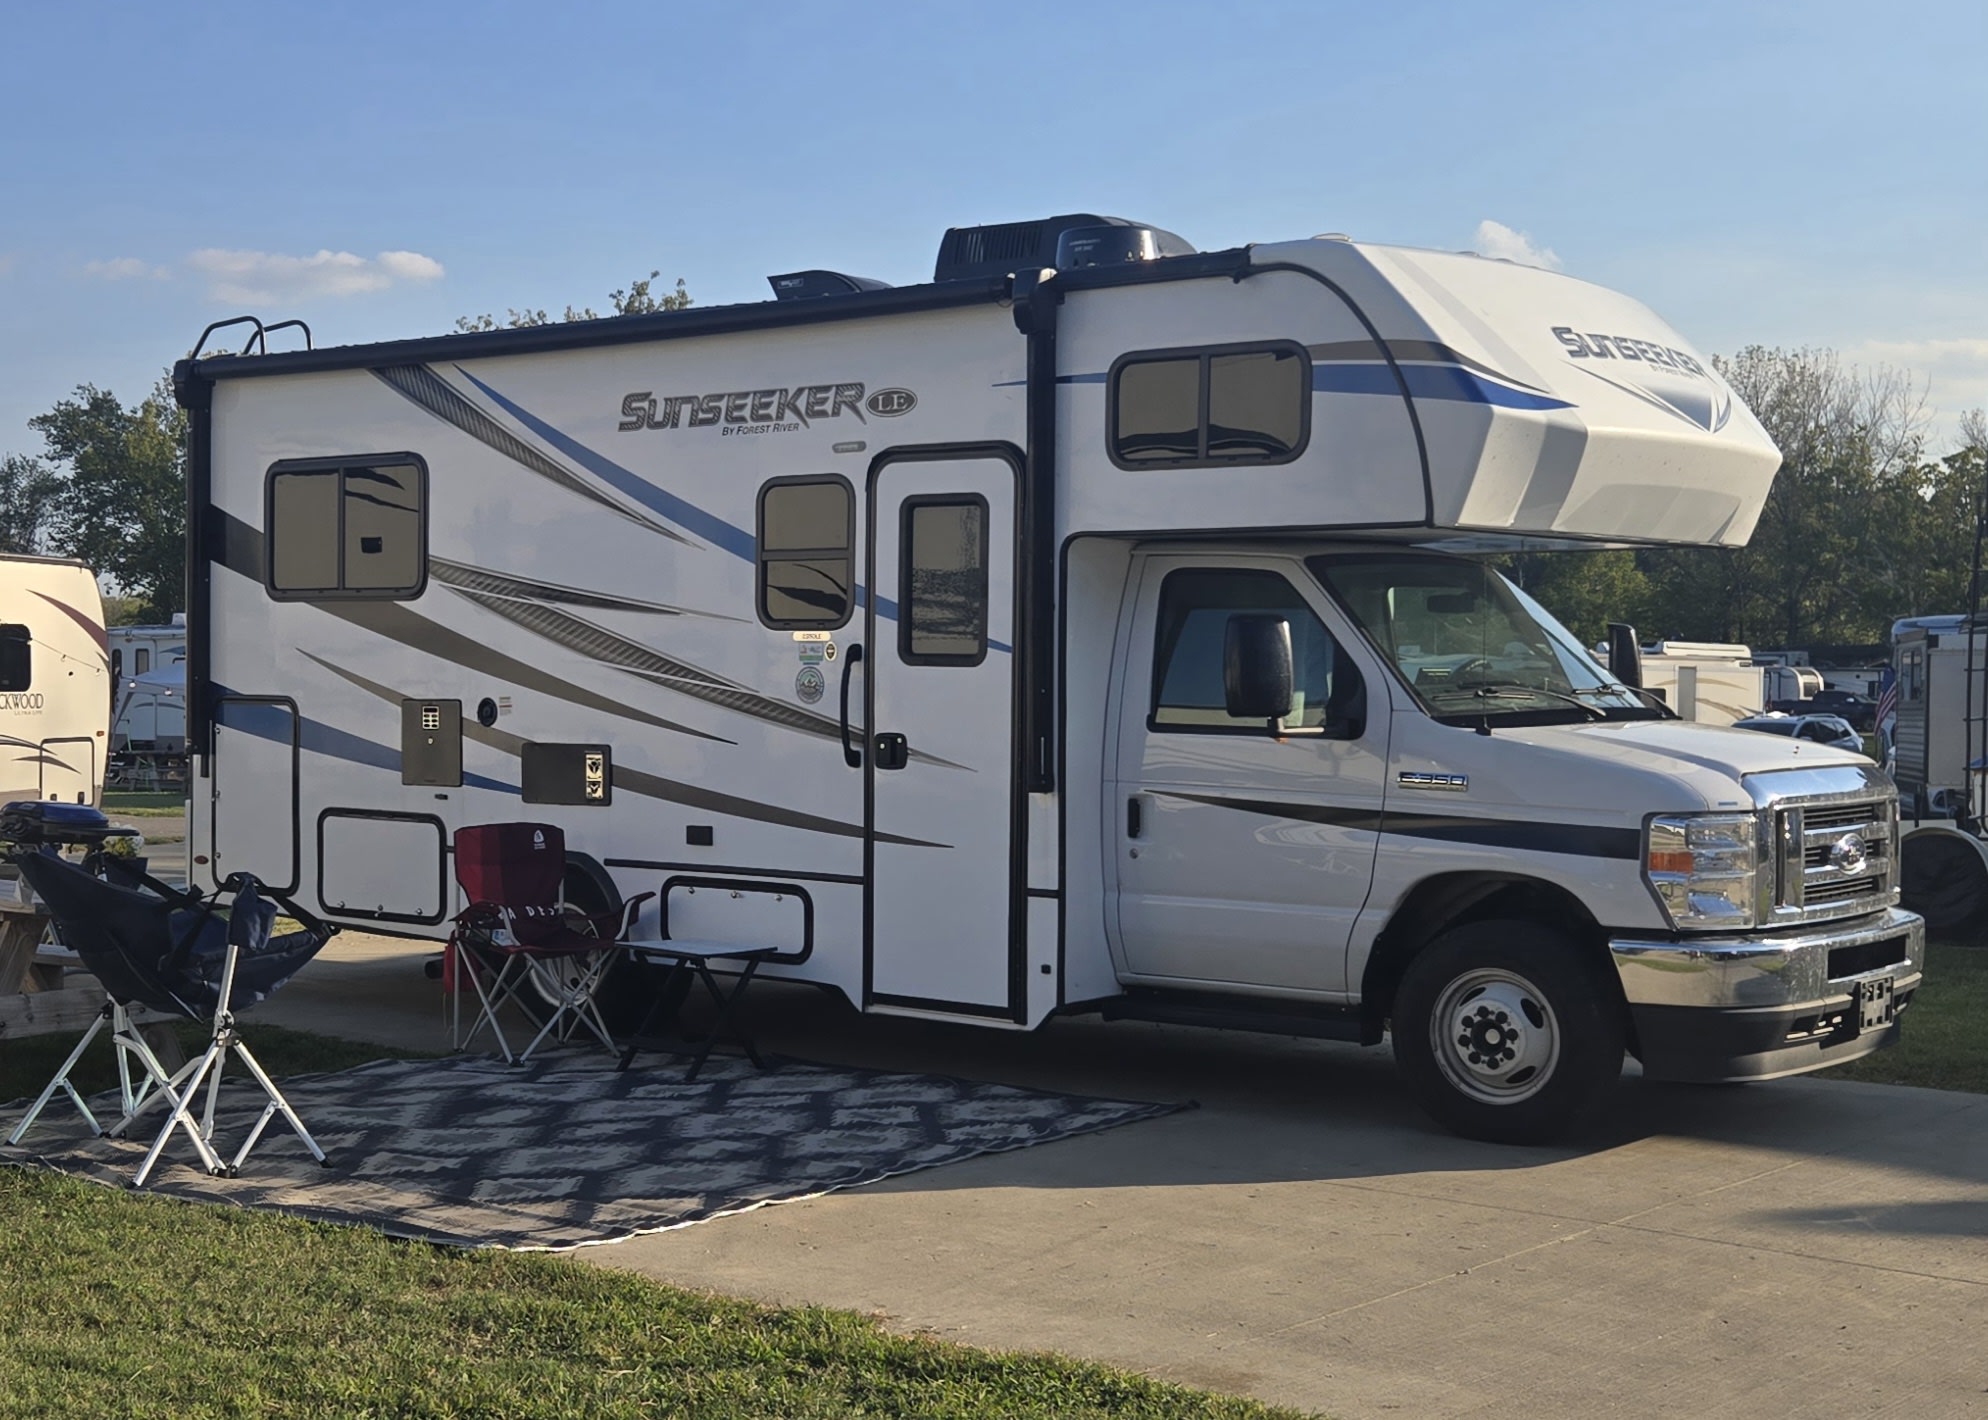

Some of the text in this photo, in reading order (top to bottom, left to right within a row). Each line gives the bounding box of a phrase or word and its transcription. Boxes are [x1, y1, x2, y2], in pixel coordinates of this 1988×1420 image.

[1551, 326, 1711, 379] SUNSEEKER
[618, 382, 909, 432] SUNSEEKER LE
[722, 422, 800, 436] BY FOREST RIVER
